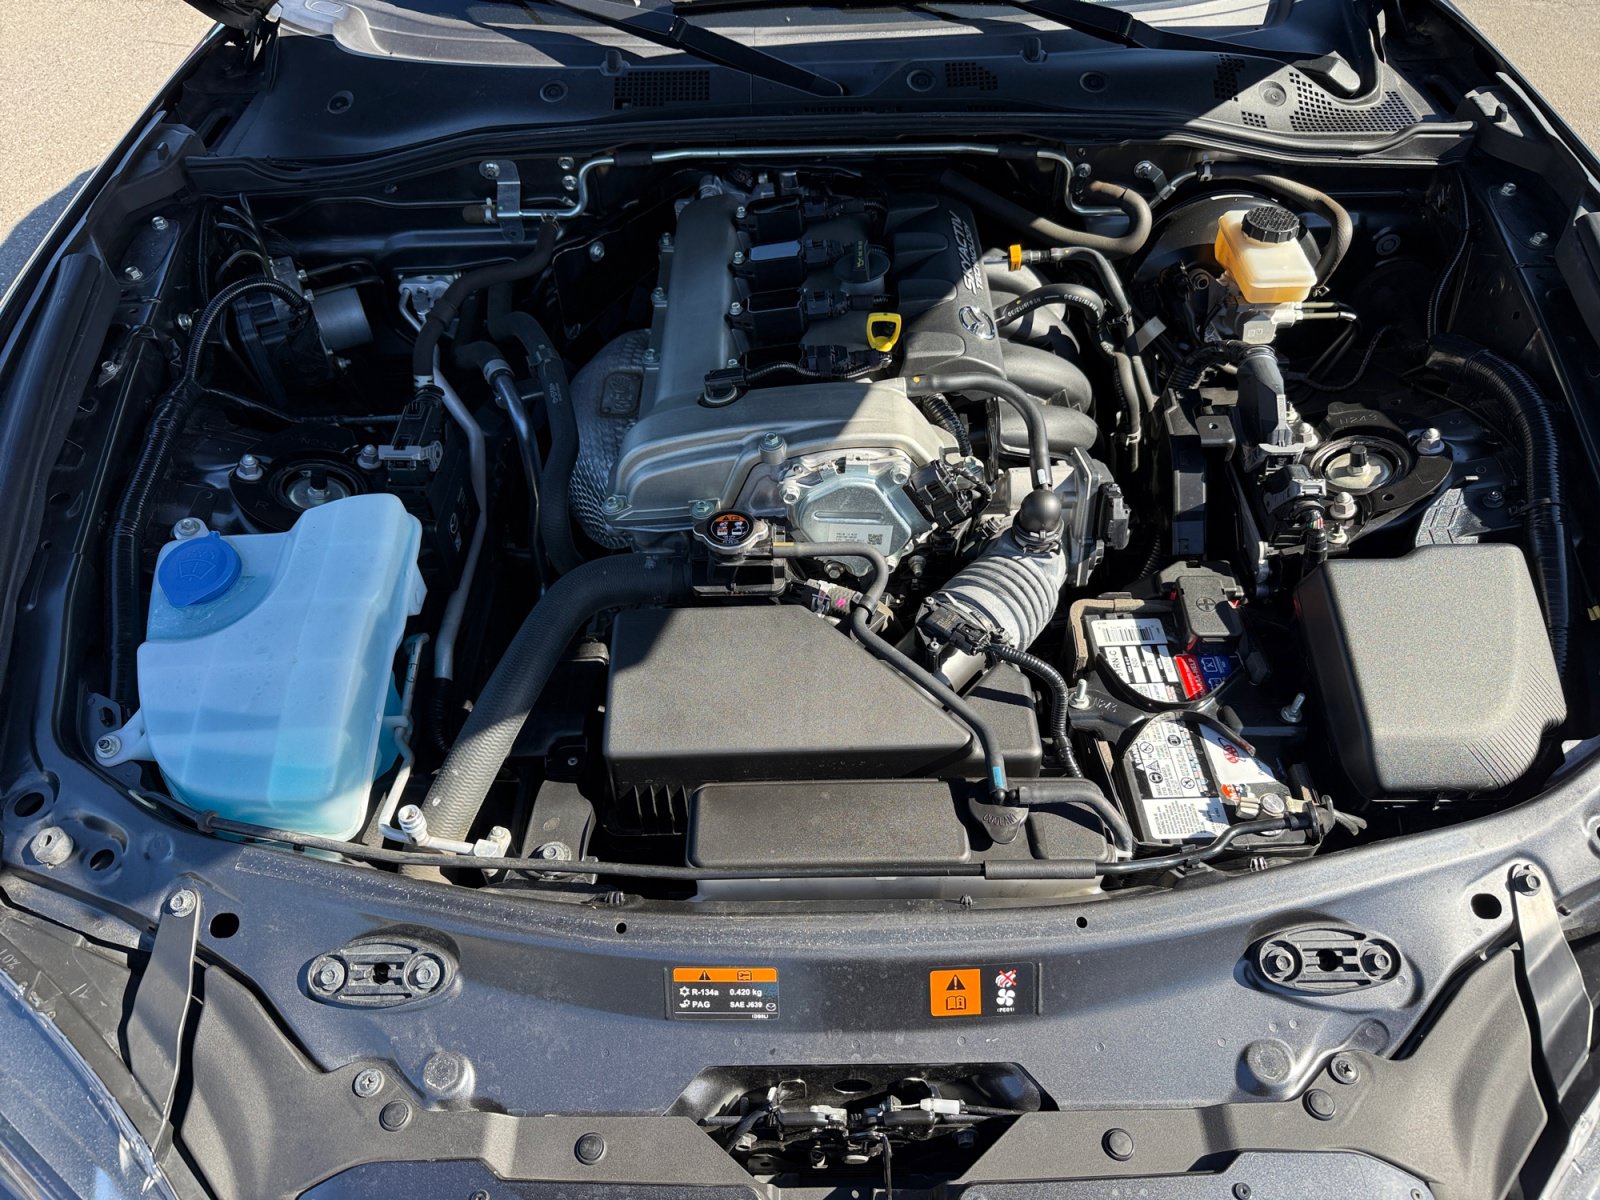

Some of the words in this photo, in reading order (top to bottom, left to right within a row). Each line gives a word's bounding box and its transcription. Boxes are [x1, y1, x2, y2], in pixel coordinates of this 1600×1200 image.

[949, 209, 977, 295] SKYACTIV
[982, 813, 1018, 826] COOLANT
[691, 988, 719, 996] R-134a
[729, 988, 750, 996] 0.420
[752, 988, 762, 997] kg
